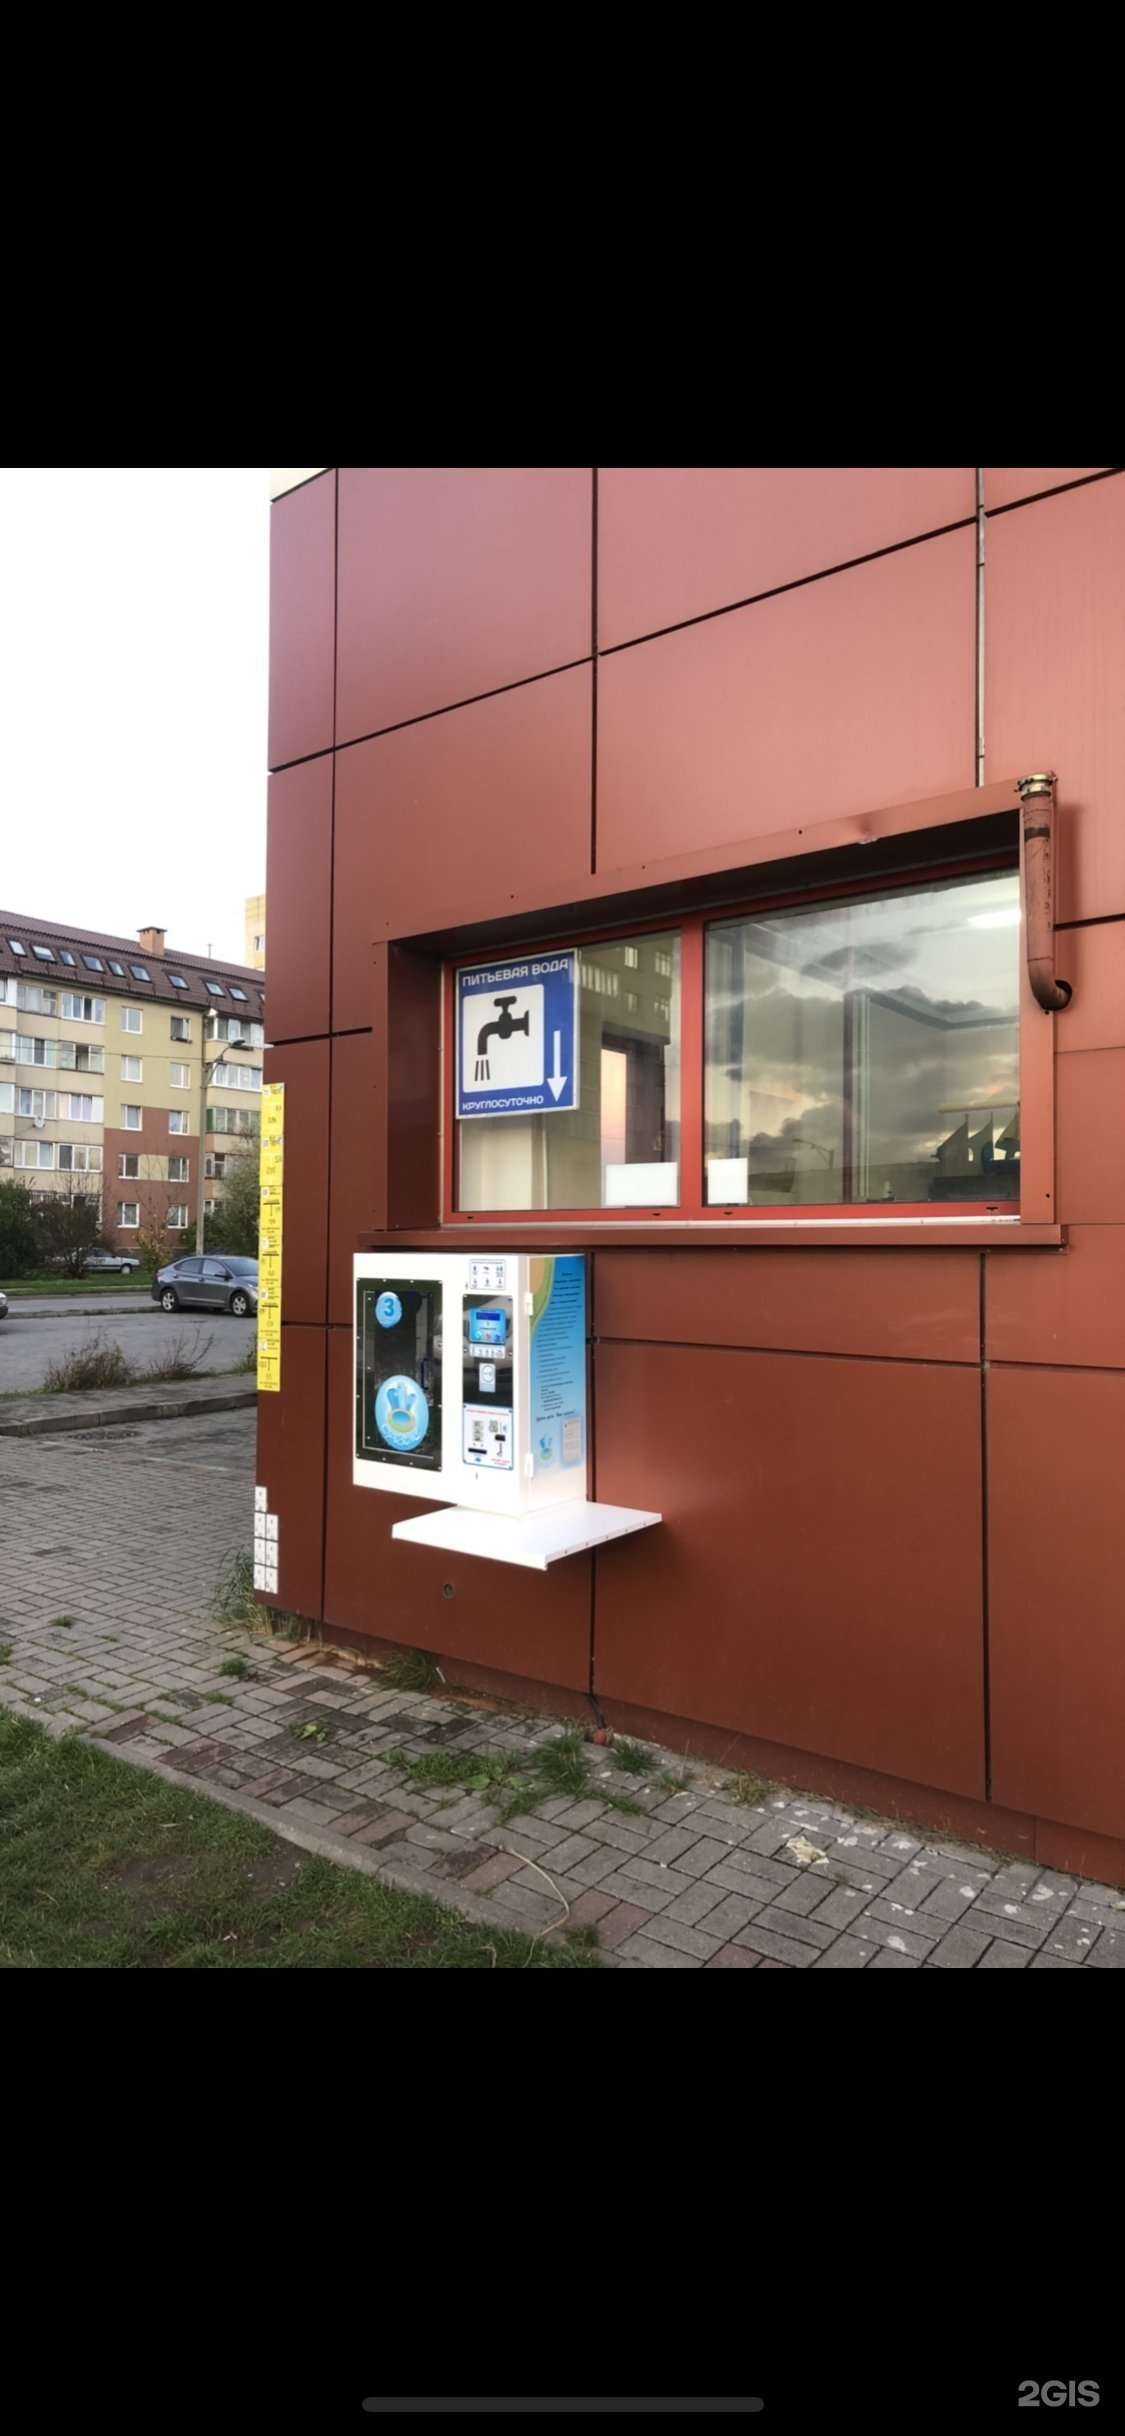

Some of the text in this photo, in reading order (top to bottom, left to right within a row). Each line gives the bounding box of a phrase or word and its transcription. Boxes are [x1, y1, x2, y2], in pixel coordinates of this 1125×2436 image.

[462, 959, 568, 987] ПИТЬЕВАЯ ВОДА
[462, 1095, 544, 1111] КРУГЛОСУТОЧНО
[383, 1298, 395, 1317] 3
